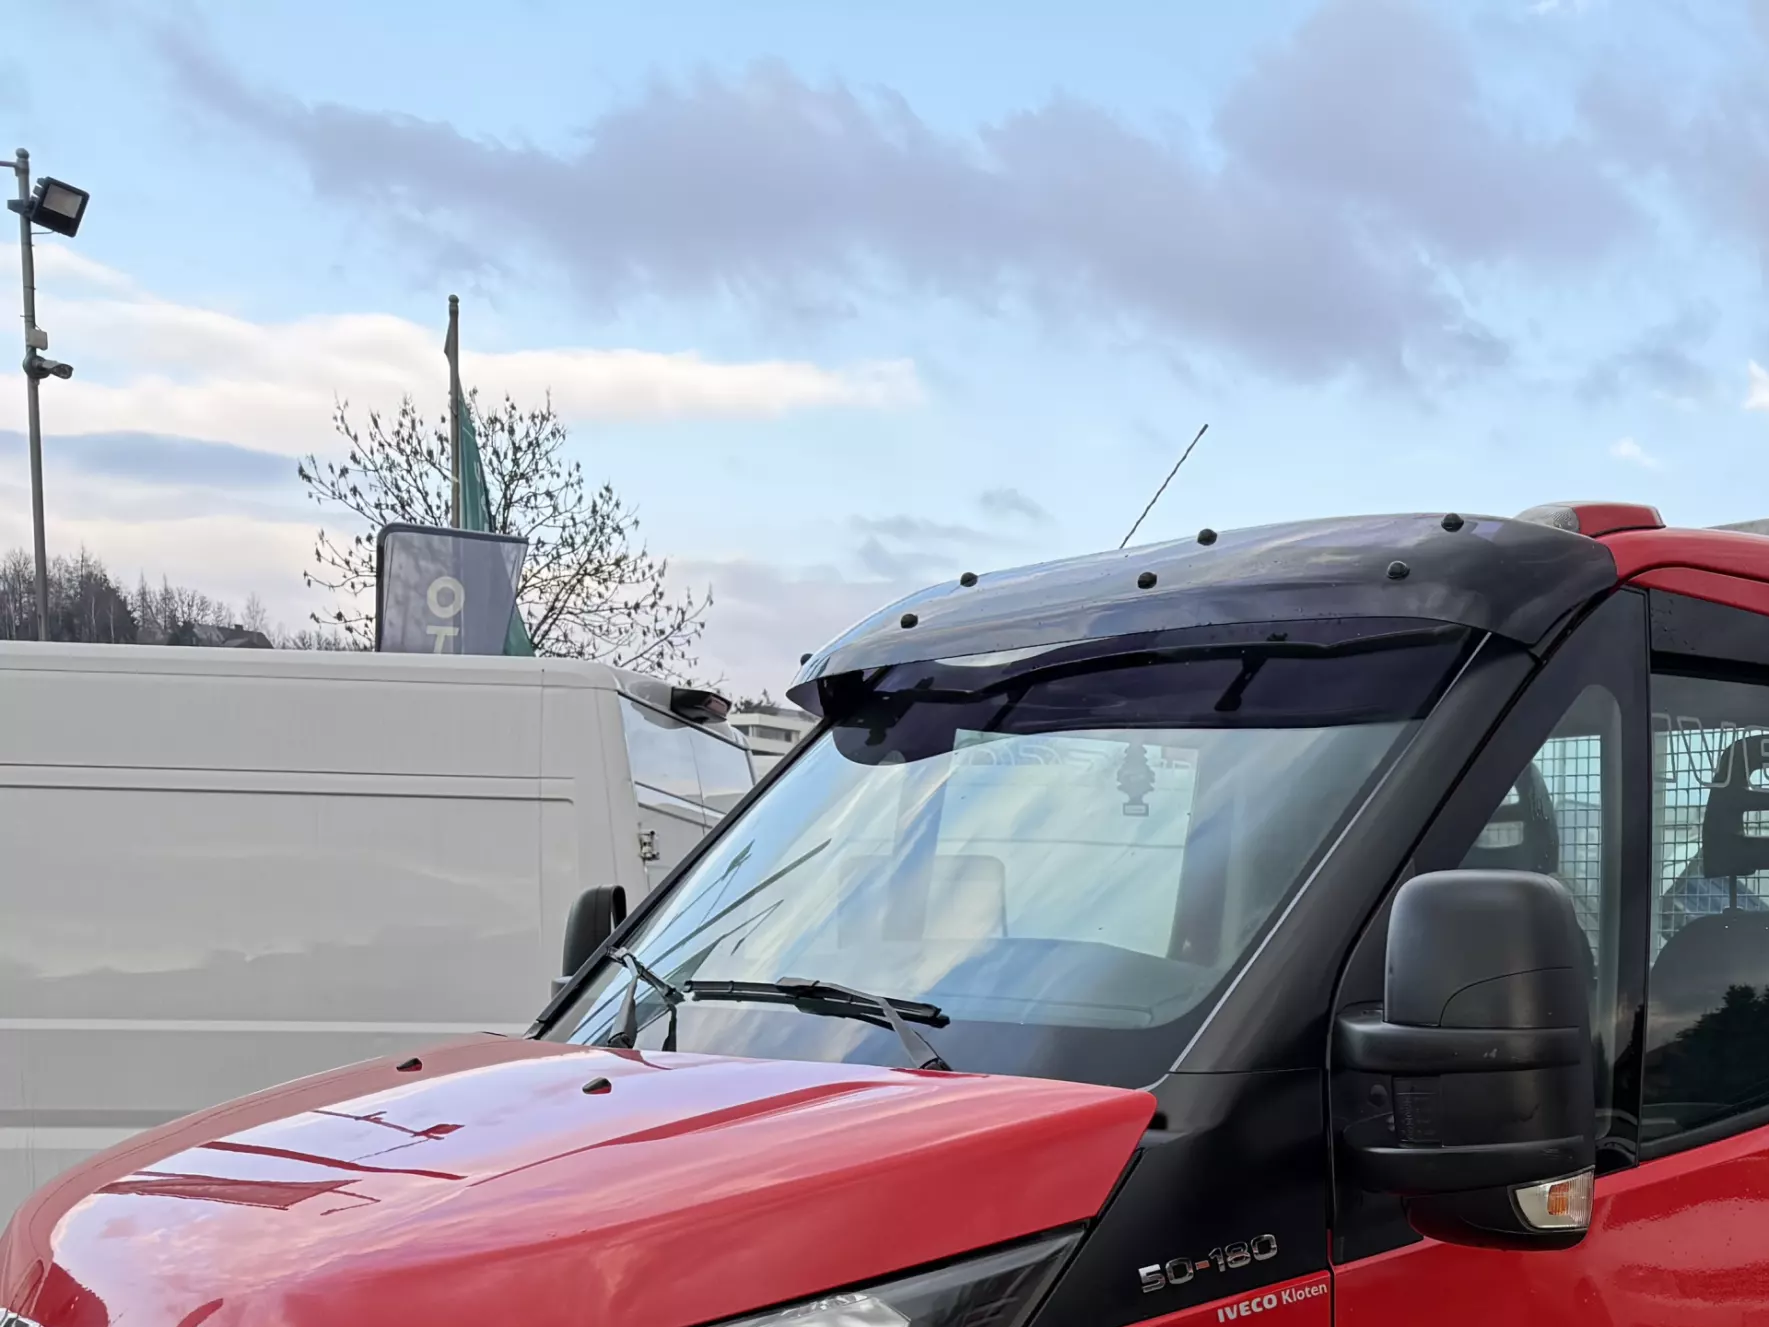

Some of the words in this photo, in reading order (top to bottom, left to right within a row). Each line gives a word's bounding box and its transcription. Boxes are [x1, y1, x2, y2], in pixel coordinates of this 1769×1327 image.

[1138, 1233, 1278, 1294] 50-180
[1217, 1294, 1278, 1323] IVECO
[1281, 1282, 1328, 1306] Kloten
